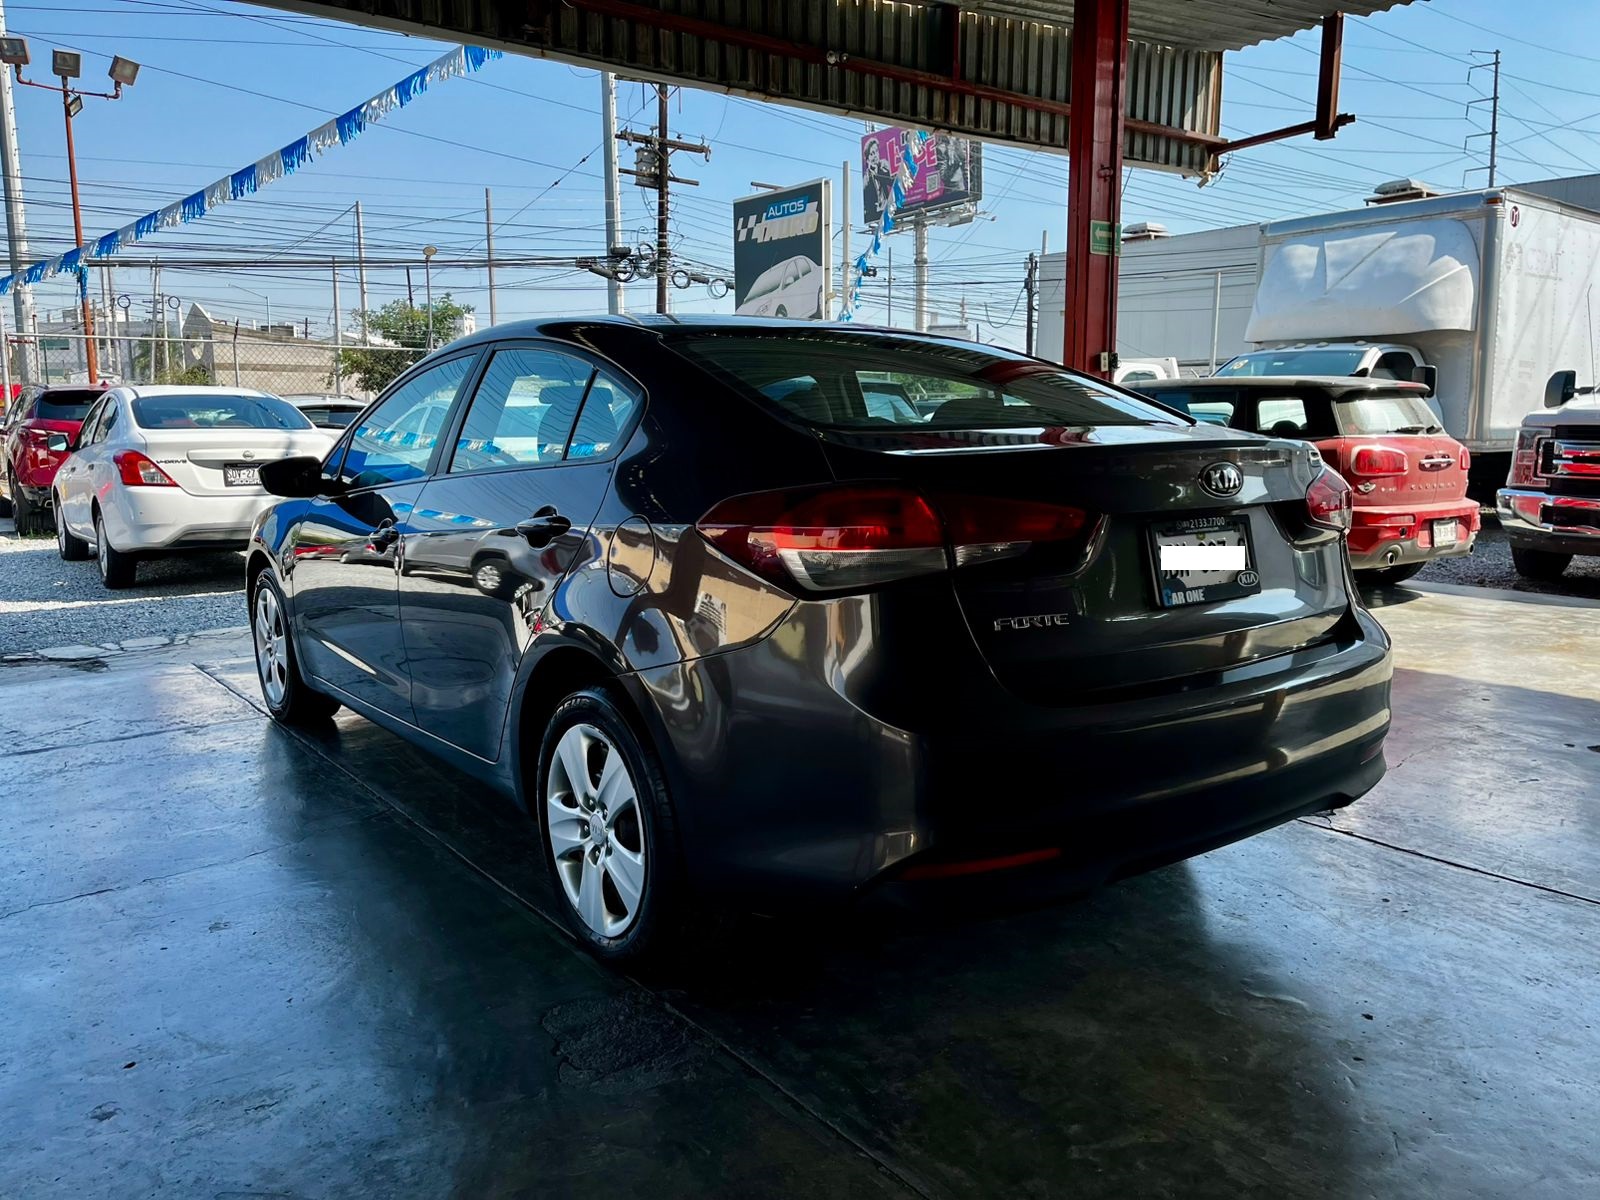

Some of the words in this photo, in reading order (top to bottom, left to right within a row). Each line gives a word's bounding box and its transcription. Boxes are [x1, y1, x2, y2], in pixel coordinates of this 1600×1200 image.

[767, 199, 805, 218] AUTOS
[1208, 467, 1240, 489] KIA
[1240, 573, 1256, 584] KIA
[1163, 588, 1186, 607] CAR
[1185, 588, 1206, 603] ONE
[993, 613, 1070, 631] FORTE
